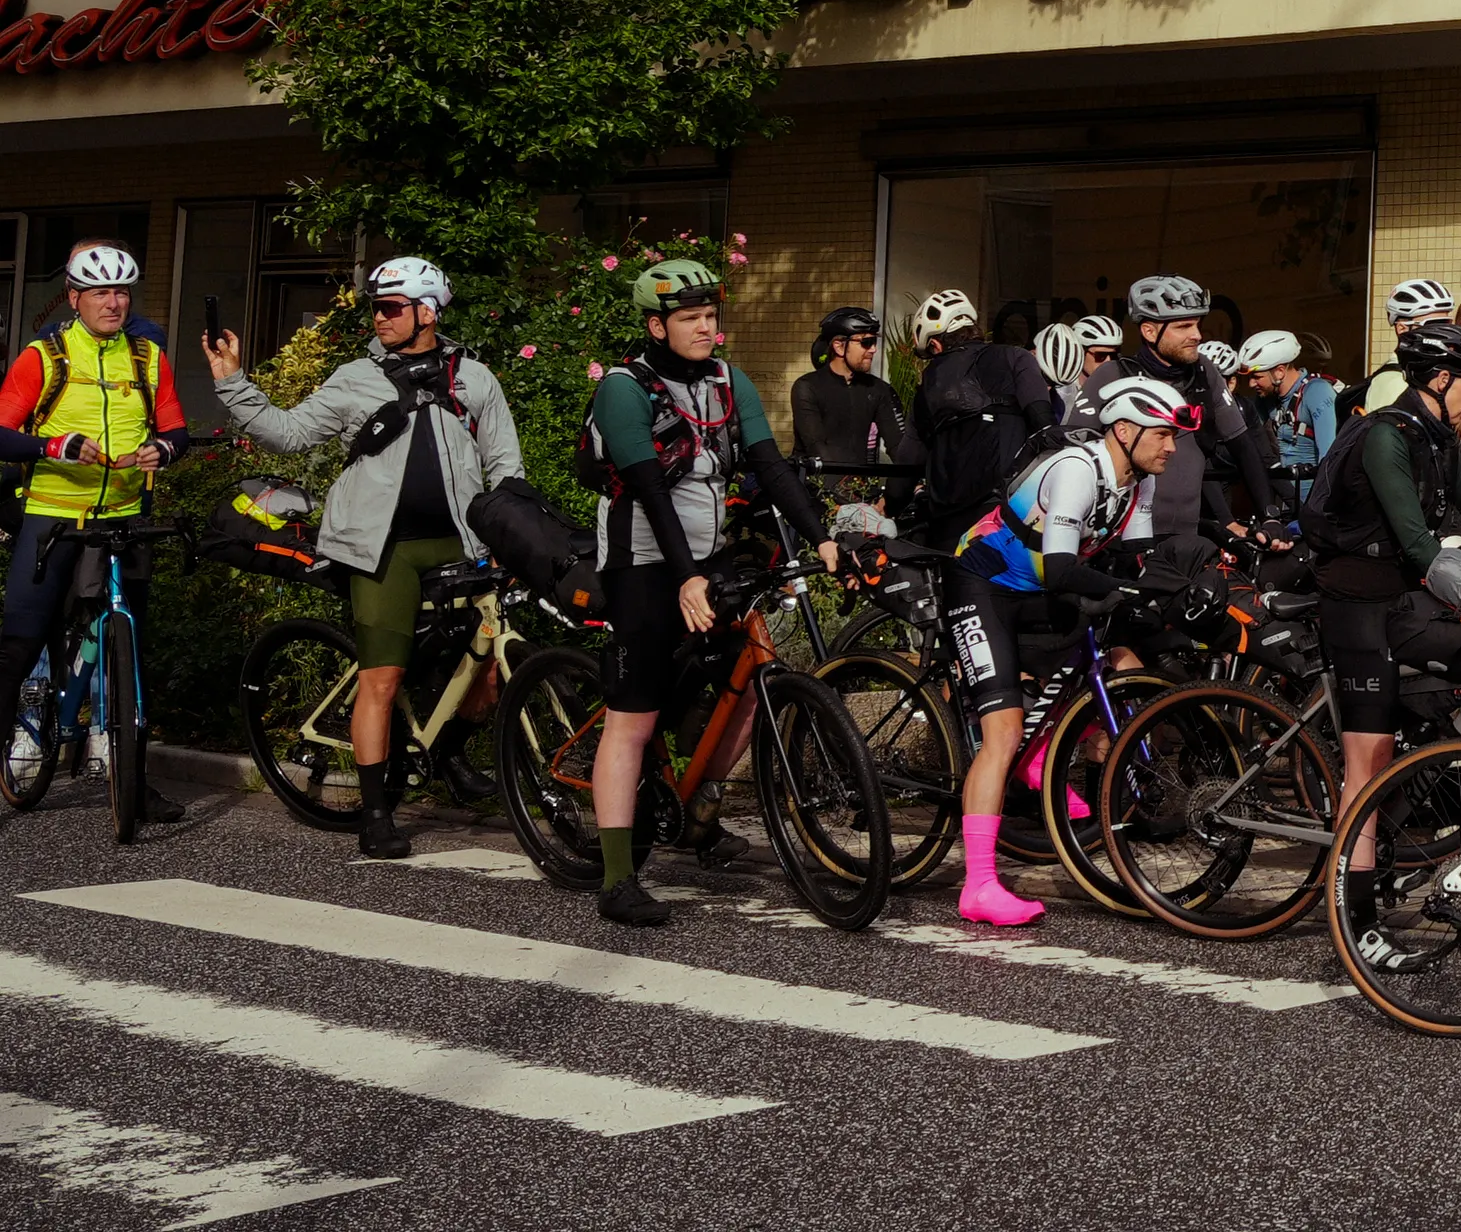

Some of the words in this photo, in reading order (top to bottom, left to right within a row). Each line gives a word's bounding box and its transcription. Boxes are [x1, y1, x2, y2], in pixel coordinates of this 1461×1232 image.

[959, 614, 987, 648] RG
[951, 622, 979, 687] HAMBURG
[1337, 855, 1347, 875] DT
[1335, 875, 1345, 907] SWISS
